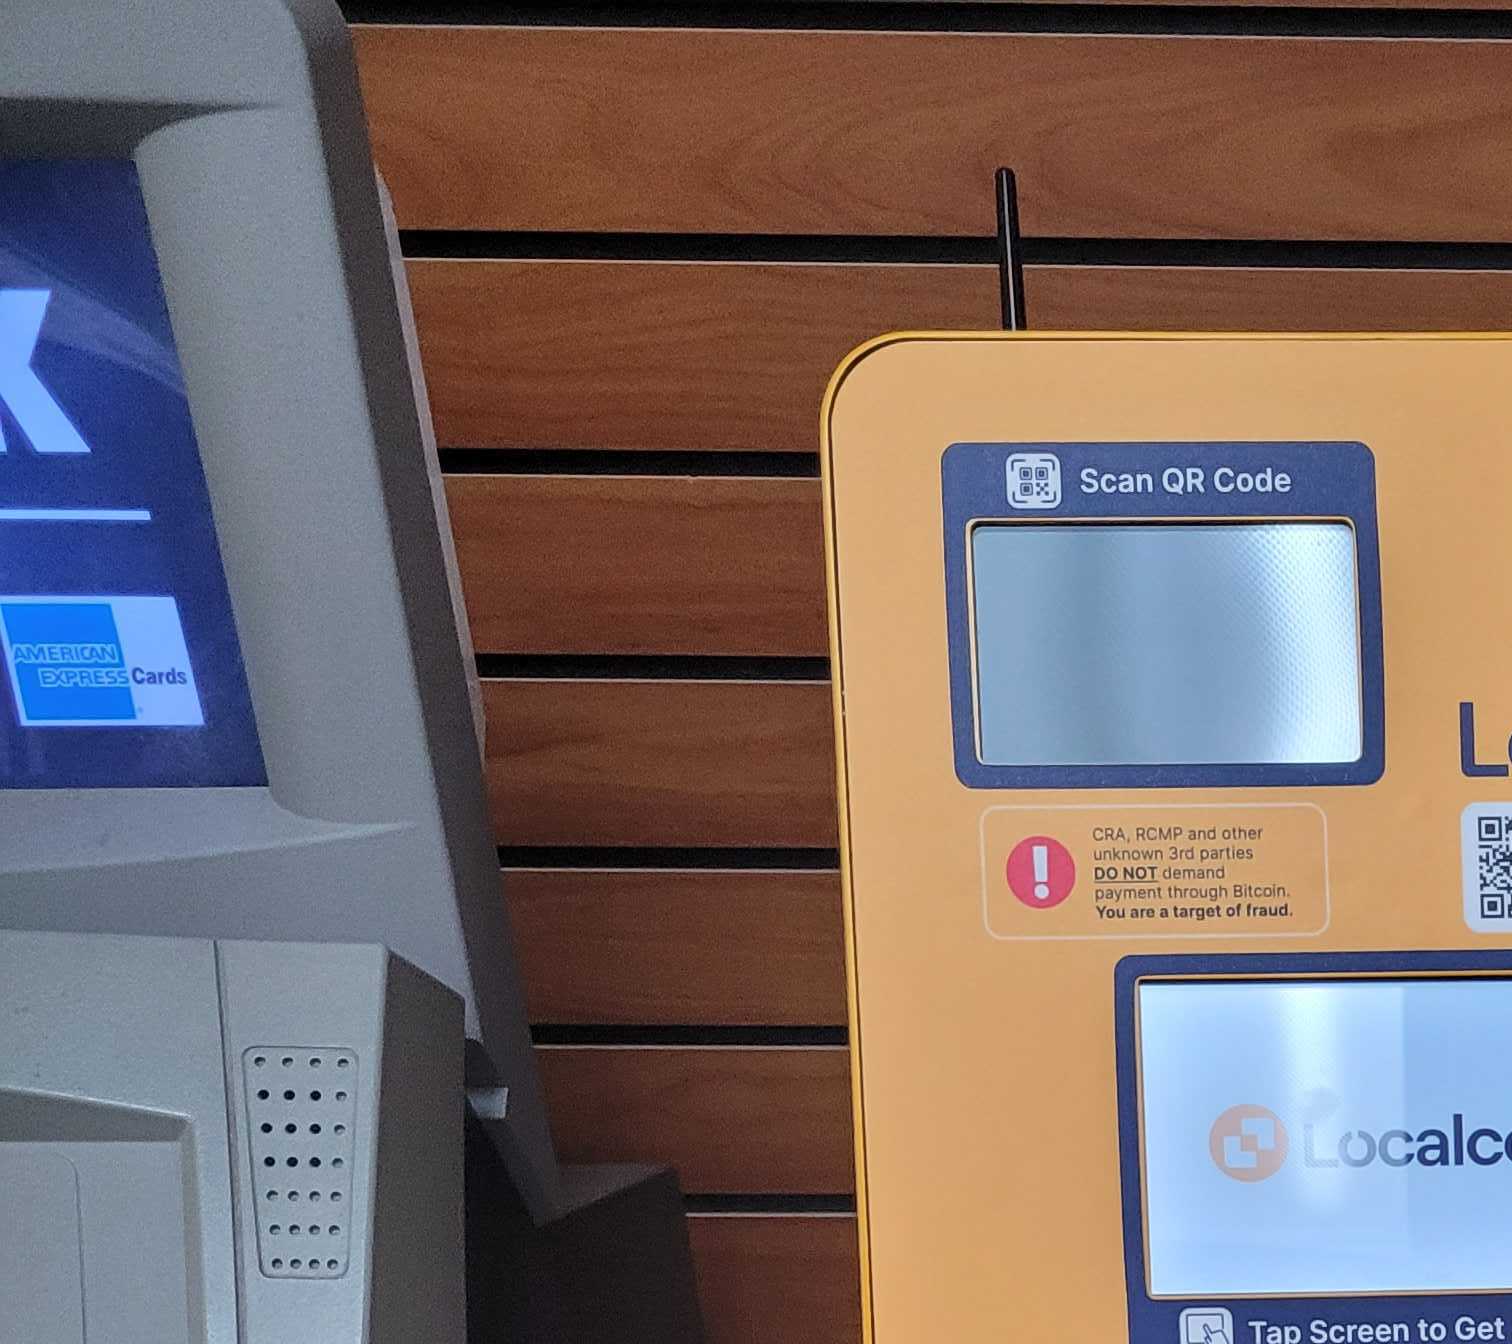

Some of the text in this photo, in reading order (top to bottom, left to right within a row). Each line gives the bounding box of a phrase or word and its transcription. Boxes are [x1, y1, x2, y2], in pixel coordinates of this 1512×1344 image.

[1080, 464, 1292, 497] Scan QR Code
[13, 644, 119, 664] AMERICAN
[38, 667, 187, 687] EXPRESS Cards
[1092, 827, 1263, 843] CRA, RCMP and other
[1093, 847, 1254, 864] unknown 3rd parties
[1094, 866, 1225, 881] DO NOT demand
[1095, 885, 1291, 903] payment through Bitcoin.
[1097, 903, 1293, 920] You are a target of fraud.
[1310, 1318, 1410, 1344] Screen
[1420, 1318, 1445, 1342] to
[1455, 1316, 1504, 1343] Get
